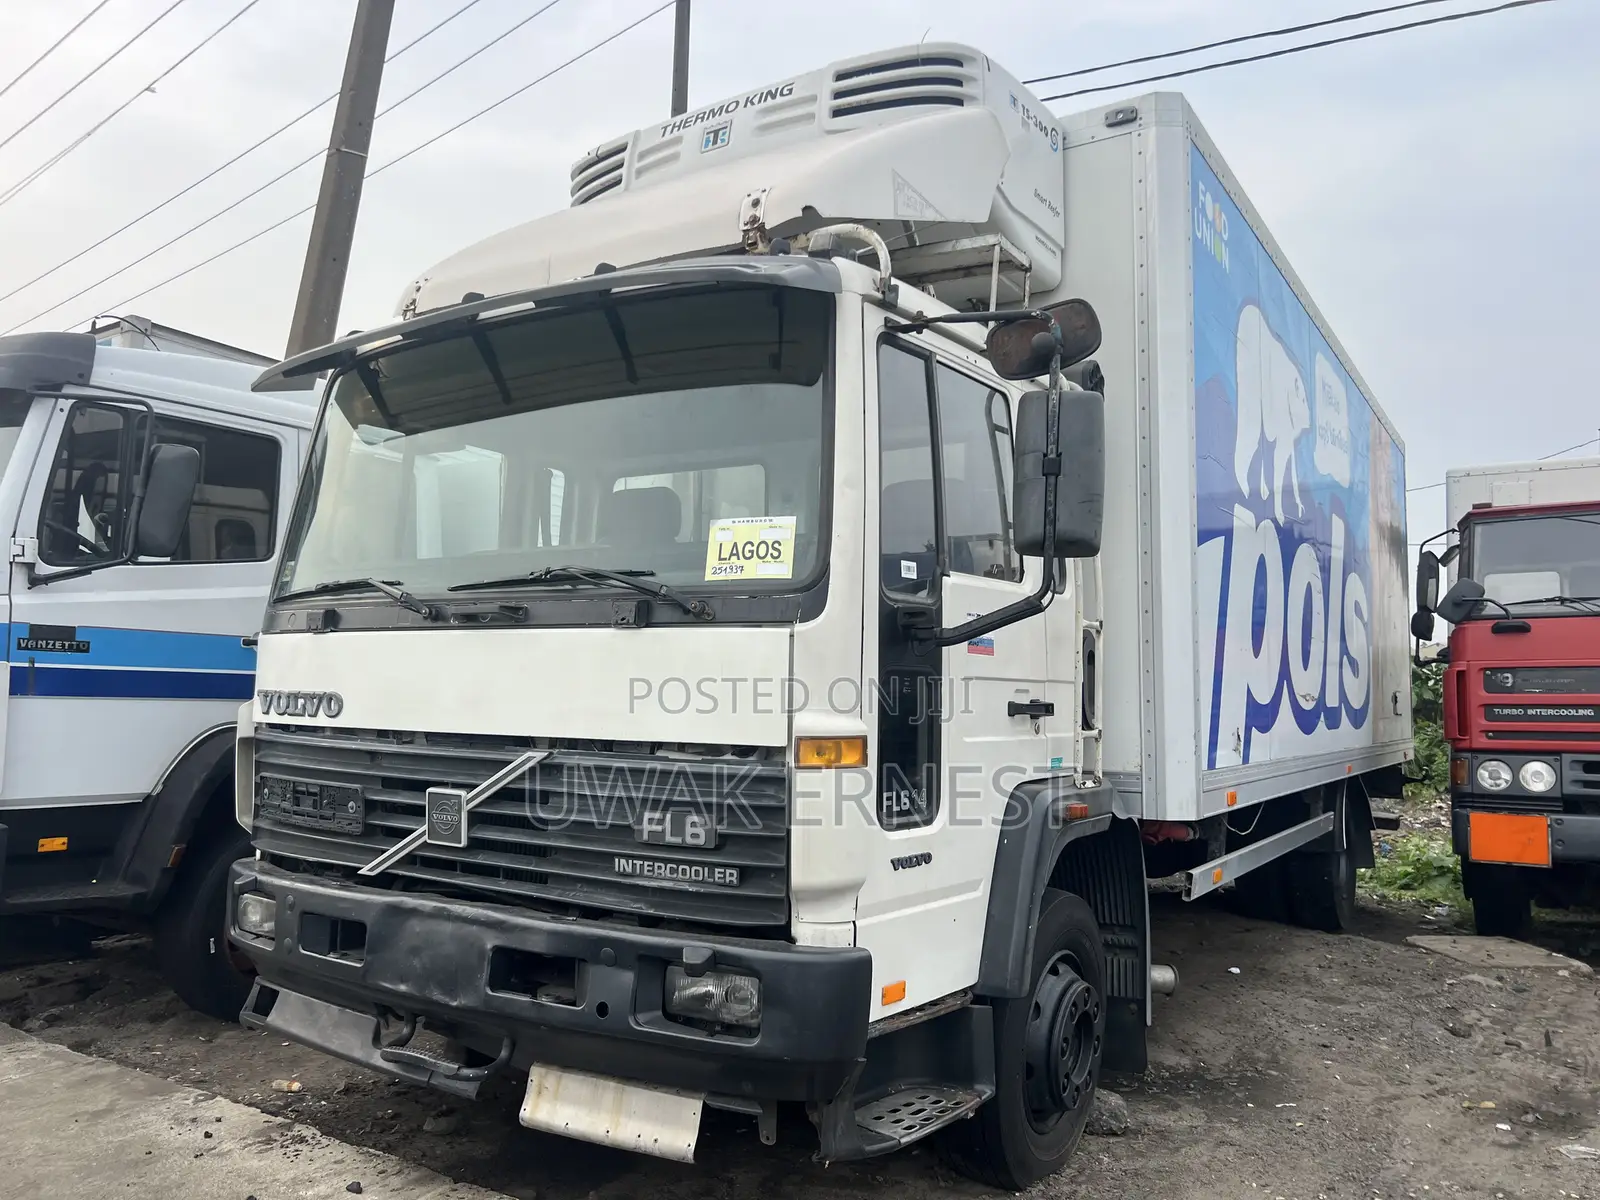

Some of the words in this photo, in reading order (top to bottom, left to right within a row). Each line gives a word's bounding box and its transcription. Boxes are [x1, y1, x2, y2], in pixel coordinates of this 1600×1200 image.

[661, 100, 740, 138] THERMO
[743, 82, 796, 109] KING
[1021, 103, 1049, 138] TS-300
[1198, 180, 1229, 241] FOOD
[1194, 207, 1230, 274] UNION
[718, 540, 782, 561] LAGOS
[711, 564, 745, 576] 251937
[19, 638, 89, 651] VANZETTO
[257, 689, 344, 719] VOLVO
[1493, 708, 1525, 716] TURBO
[1527, 708, 1595, 716] INTERCOOLING
[883, 789, 910, 813] FL6
[432, 813, 458, 822] VOLVO
[641, 811, 707, 847] FL6
[613, 857, 739, 886] INTERCOOLER
[890, 851, 933, 872] VOLVO
